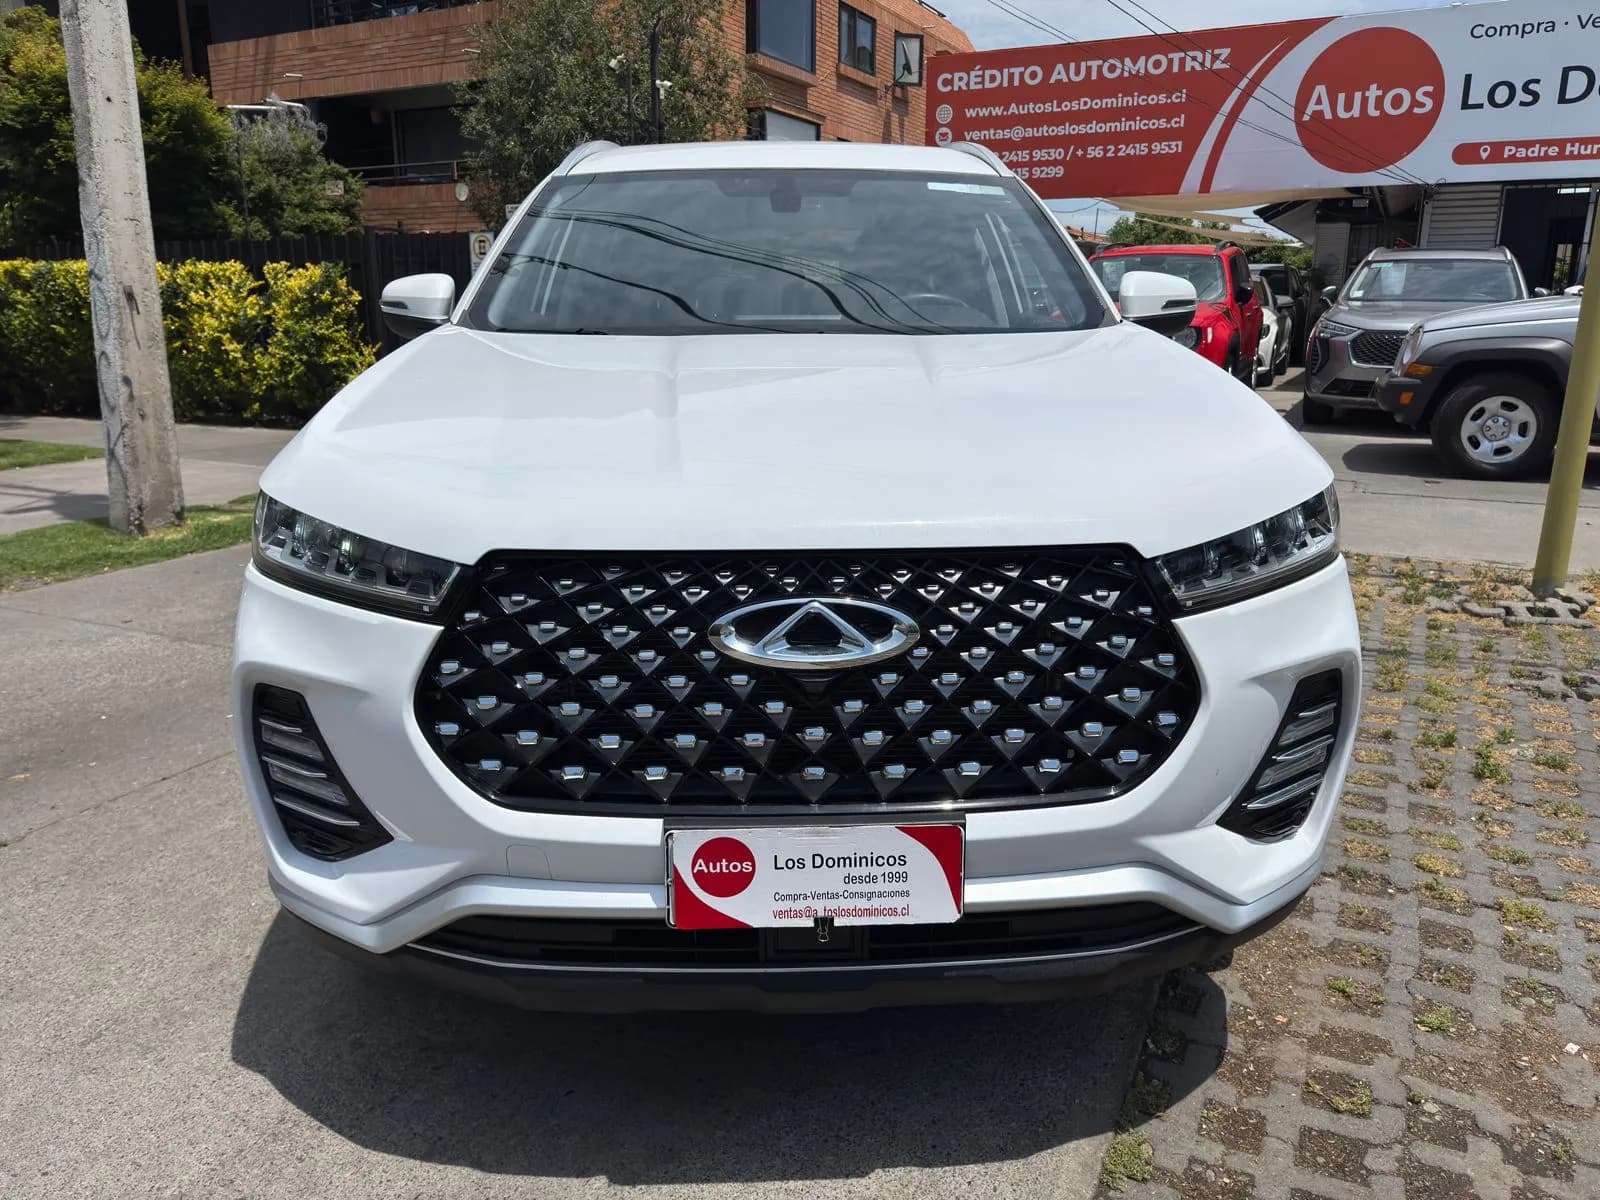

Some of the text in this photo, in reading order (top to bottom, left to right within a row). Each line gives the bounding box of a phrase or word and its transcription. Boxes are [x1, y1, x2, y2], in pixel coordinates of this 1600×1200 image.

[1470, 18, 1556, 39] Compra
[936, 48, 1232, 93] CRÉDITO AUTOMOTRIZ
[1460, 65, 1600, 110] Los D
[1302, 83, 1435, 121] Autos
[964, 115, 1185, 141] ventas@autoslosdominicos.cl
[1002, 150, 1030, 163] 2415
[1032, 149, 1065, 161] 9530
[1086, 146, 1104, 158] 56
[1106, 145, 1115, 157] 2
[1117, 143, 1149, 156] 2415
[1151, 141, 1183, 154] 9531
[1503, 144, 1560, 158] Padre
[1032, 166, 1065, 178] 9299
[693, 858, 753, 874] Autos
[773, 852, 908, 870] Los Dominicos
[843, 871, 909, 885] desde 1999
[773, 889, 911, 903] Compra-Ventas-Consignaciones
[772, 904, 910, 919] ventas@atoslosdominicos.cl
